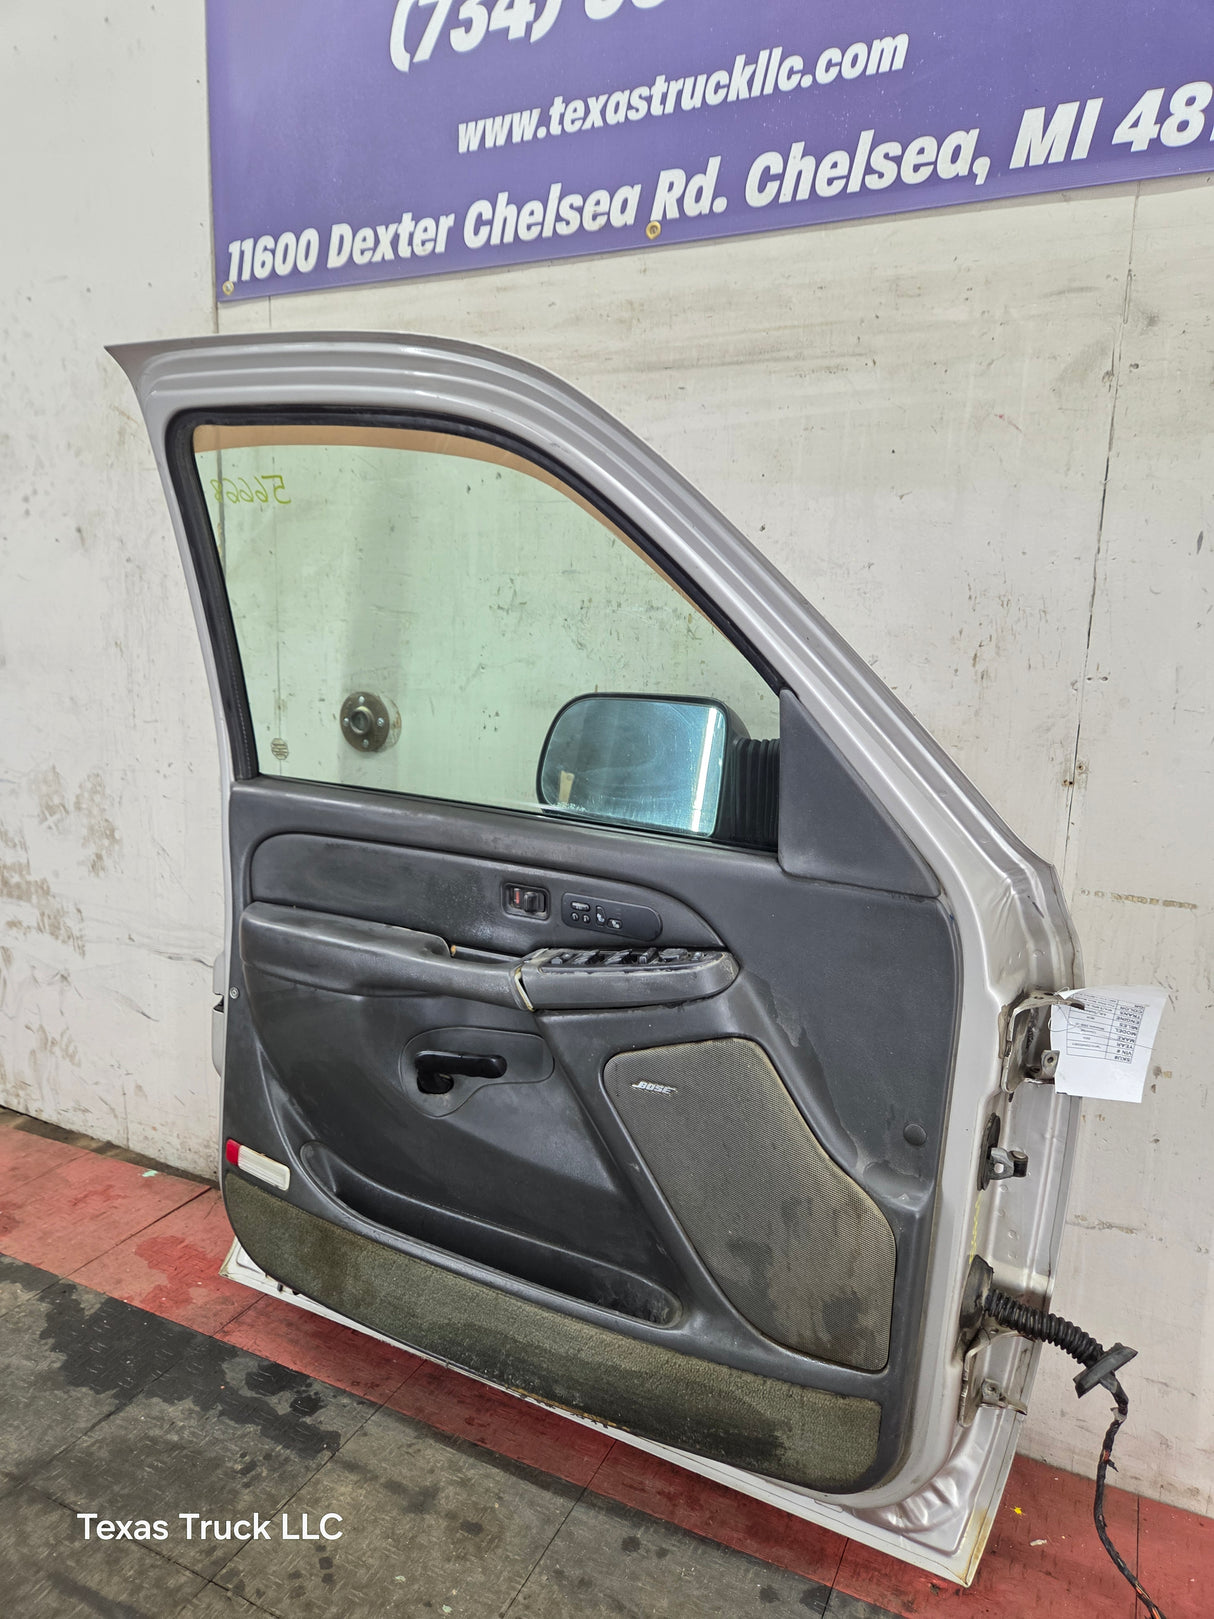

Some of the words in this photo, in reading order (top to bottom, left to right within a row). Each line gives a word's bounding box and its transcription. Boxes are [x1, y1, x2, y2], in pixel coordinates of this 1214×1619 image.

[458, 33, 909, 153] www.texastruckllc.com
[228, 228, 319, 283] 11600
[327, 211, 455, 269] Dexter
[463, 182, 642, 249] Chelsea
[650, 156, 728, 221] Rd.
[745, 129, 991, 208] Chelsea,
[1009, 97, 1104, 170] MI
[1112, 81, 1214, 152] 48
[632, 1081, 678, 1096] BOSE
